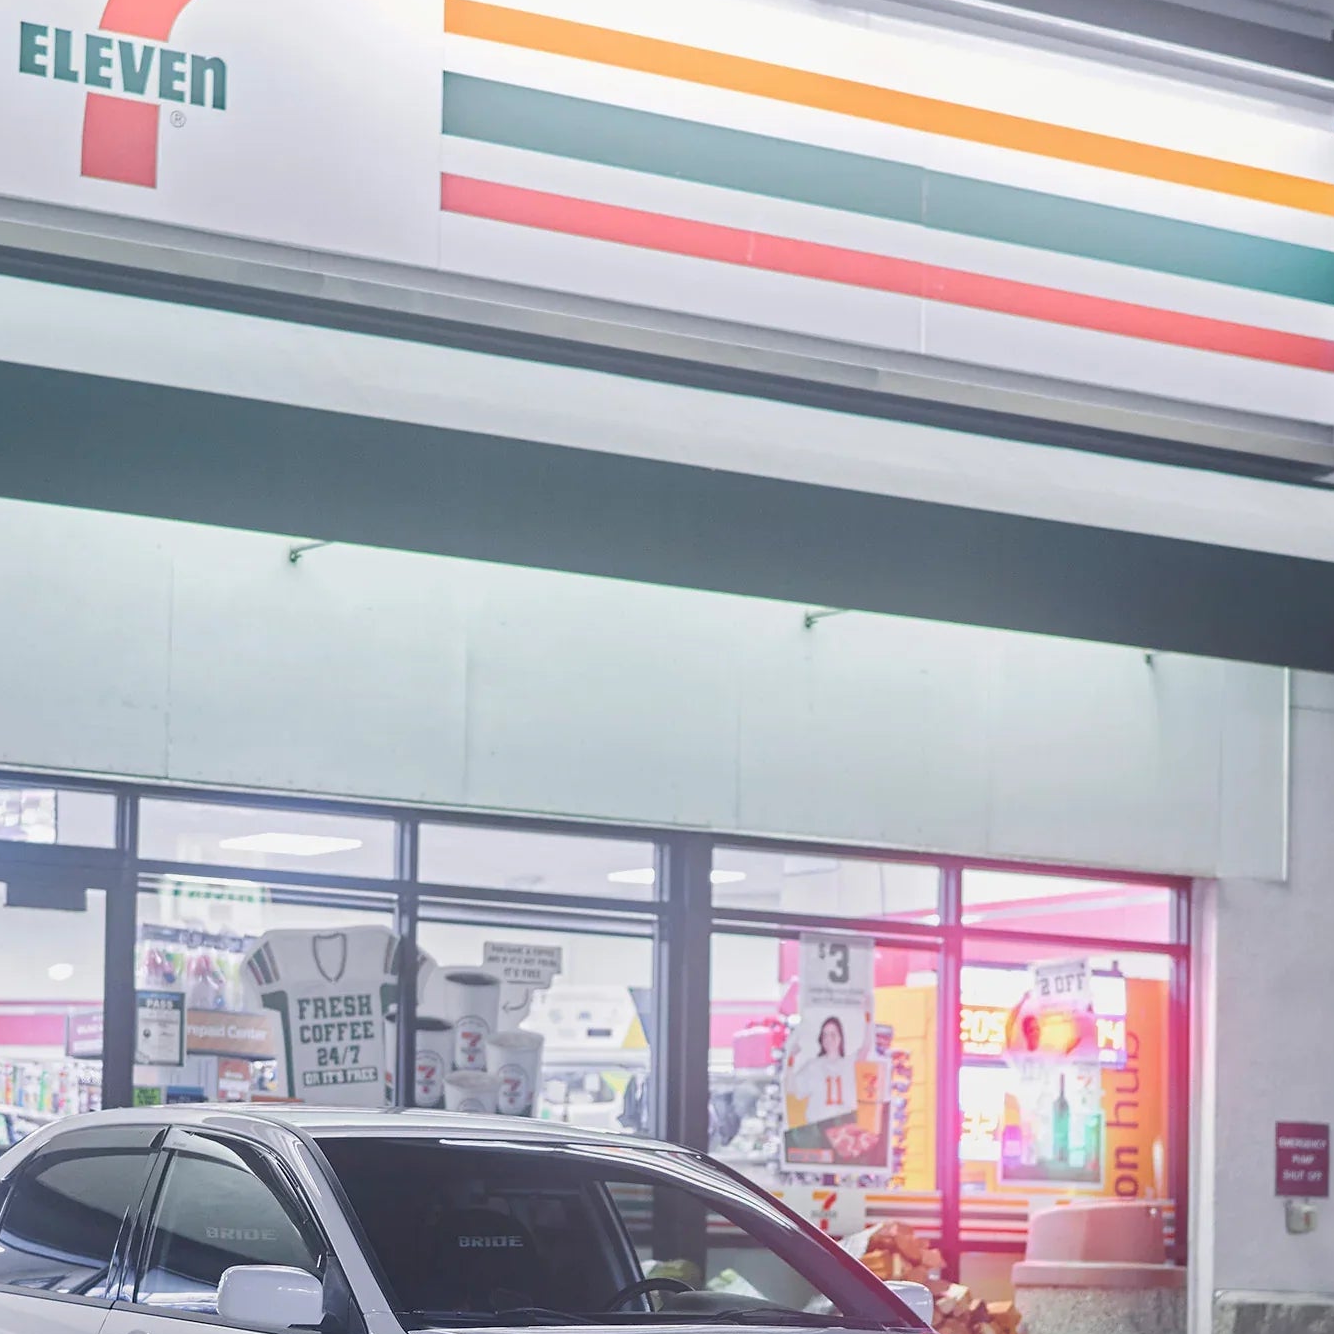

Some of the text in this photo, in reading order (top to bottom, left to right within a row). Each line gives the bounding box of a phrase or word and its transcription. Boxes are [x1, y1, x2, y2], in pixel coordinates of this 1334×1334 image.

[297, 994, 373, 1020] FRESH
[299, 1020, 375, 1044] COFFEE
[317, 1045, 361, 1066] 24/7
[347, 1068, 378, 1083] FREE
[205, 1226, 277, 1241] BRIDE
[458, 1235, 524, 1248] BRIDE
